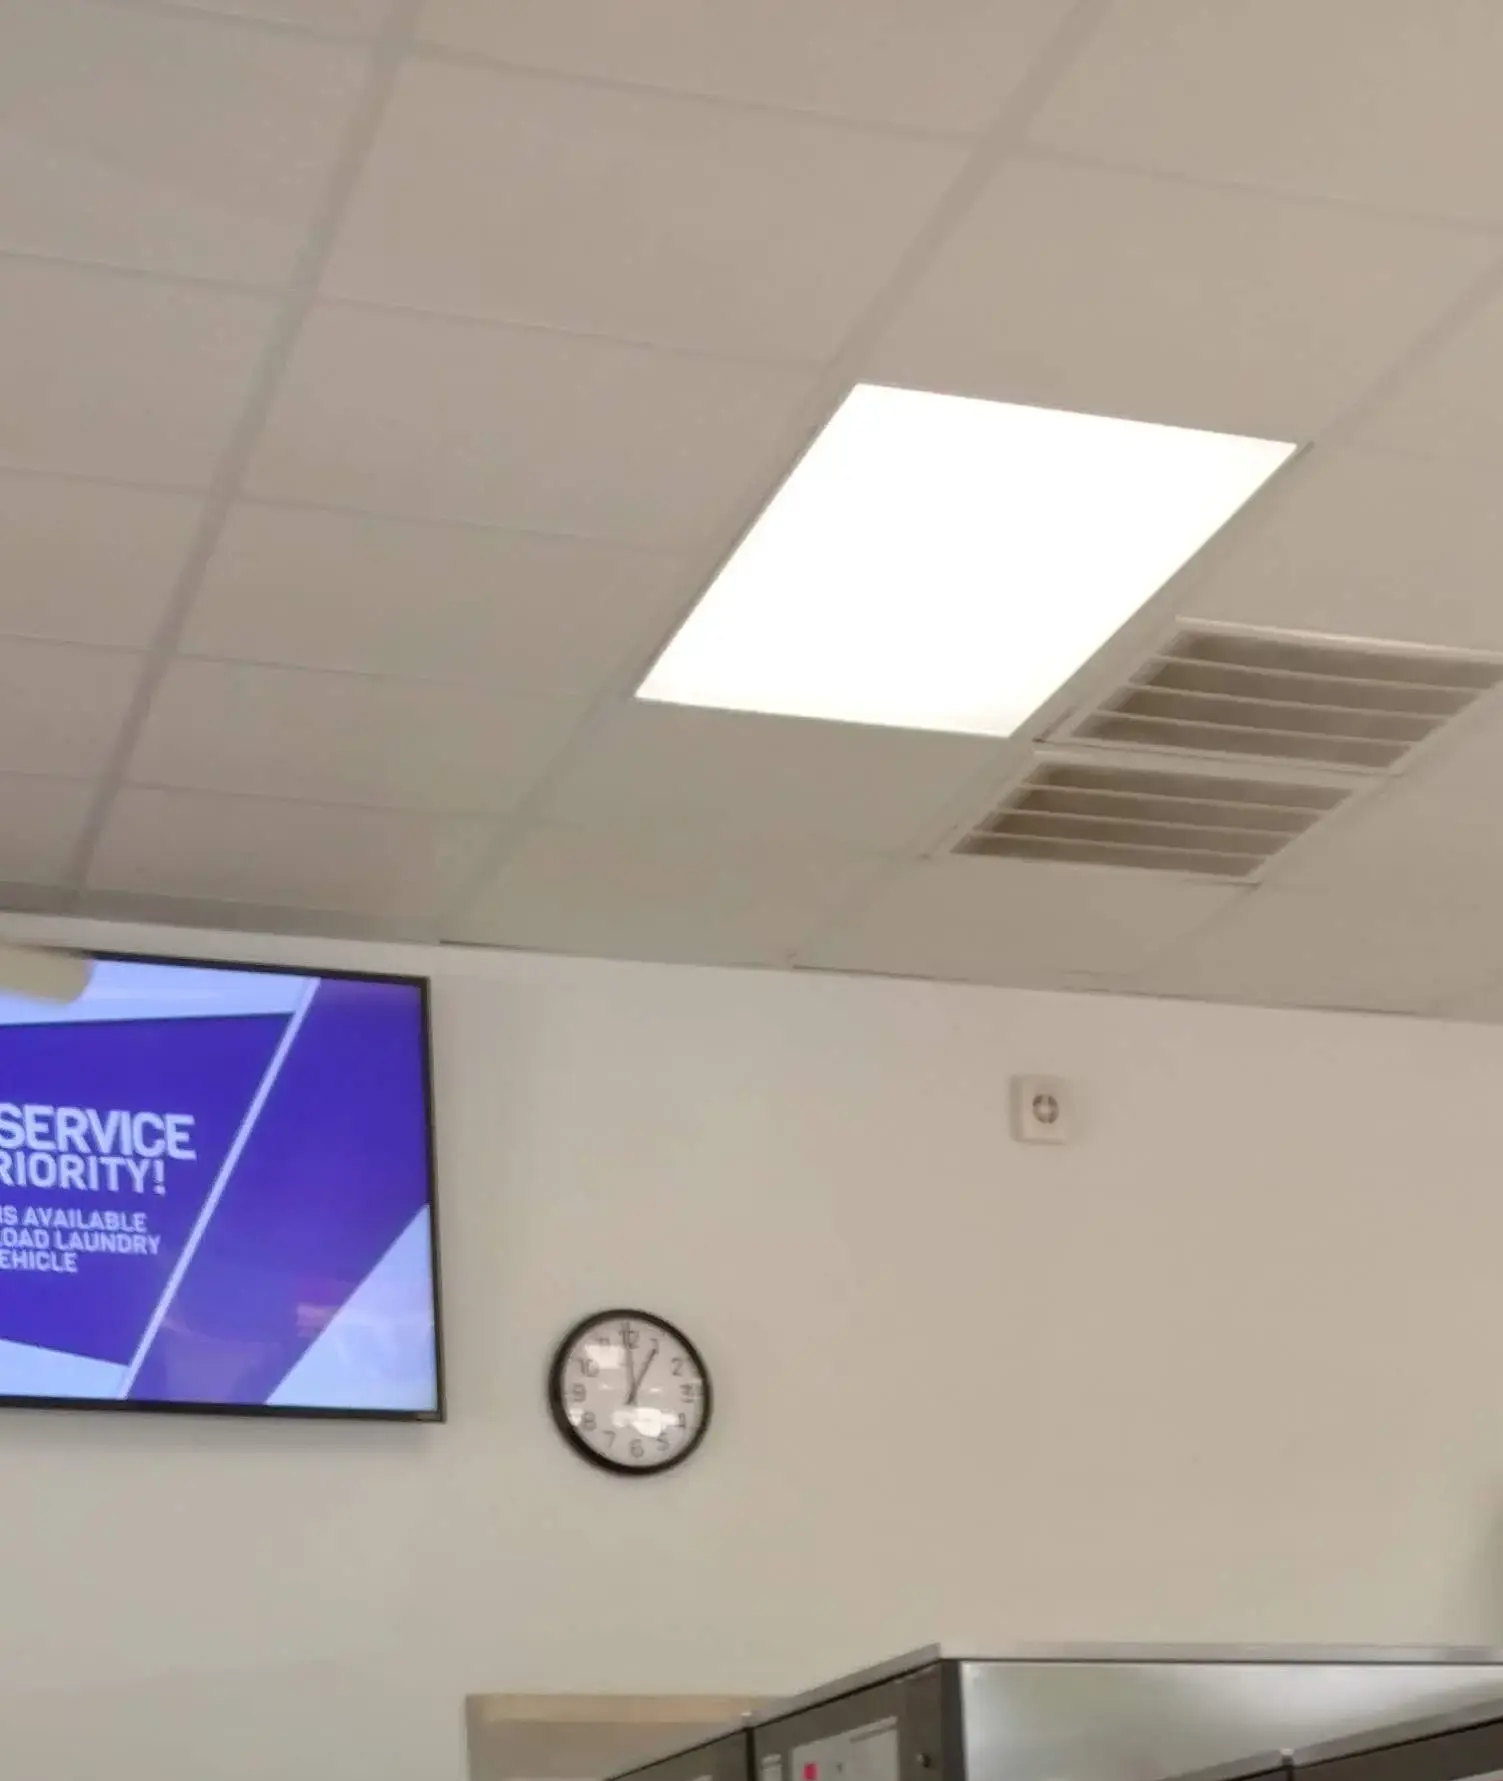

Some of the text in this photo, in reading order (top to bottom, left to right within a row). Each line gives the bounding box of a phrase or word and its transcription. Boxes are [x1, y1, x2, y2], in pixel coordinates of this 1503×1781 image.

[0, 1103, 197, 1160] SERVICE
[22, 1206, 148, 1233] AVAILABLE
[55, 1230, 161, 1255] LAUNDRY
